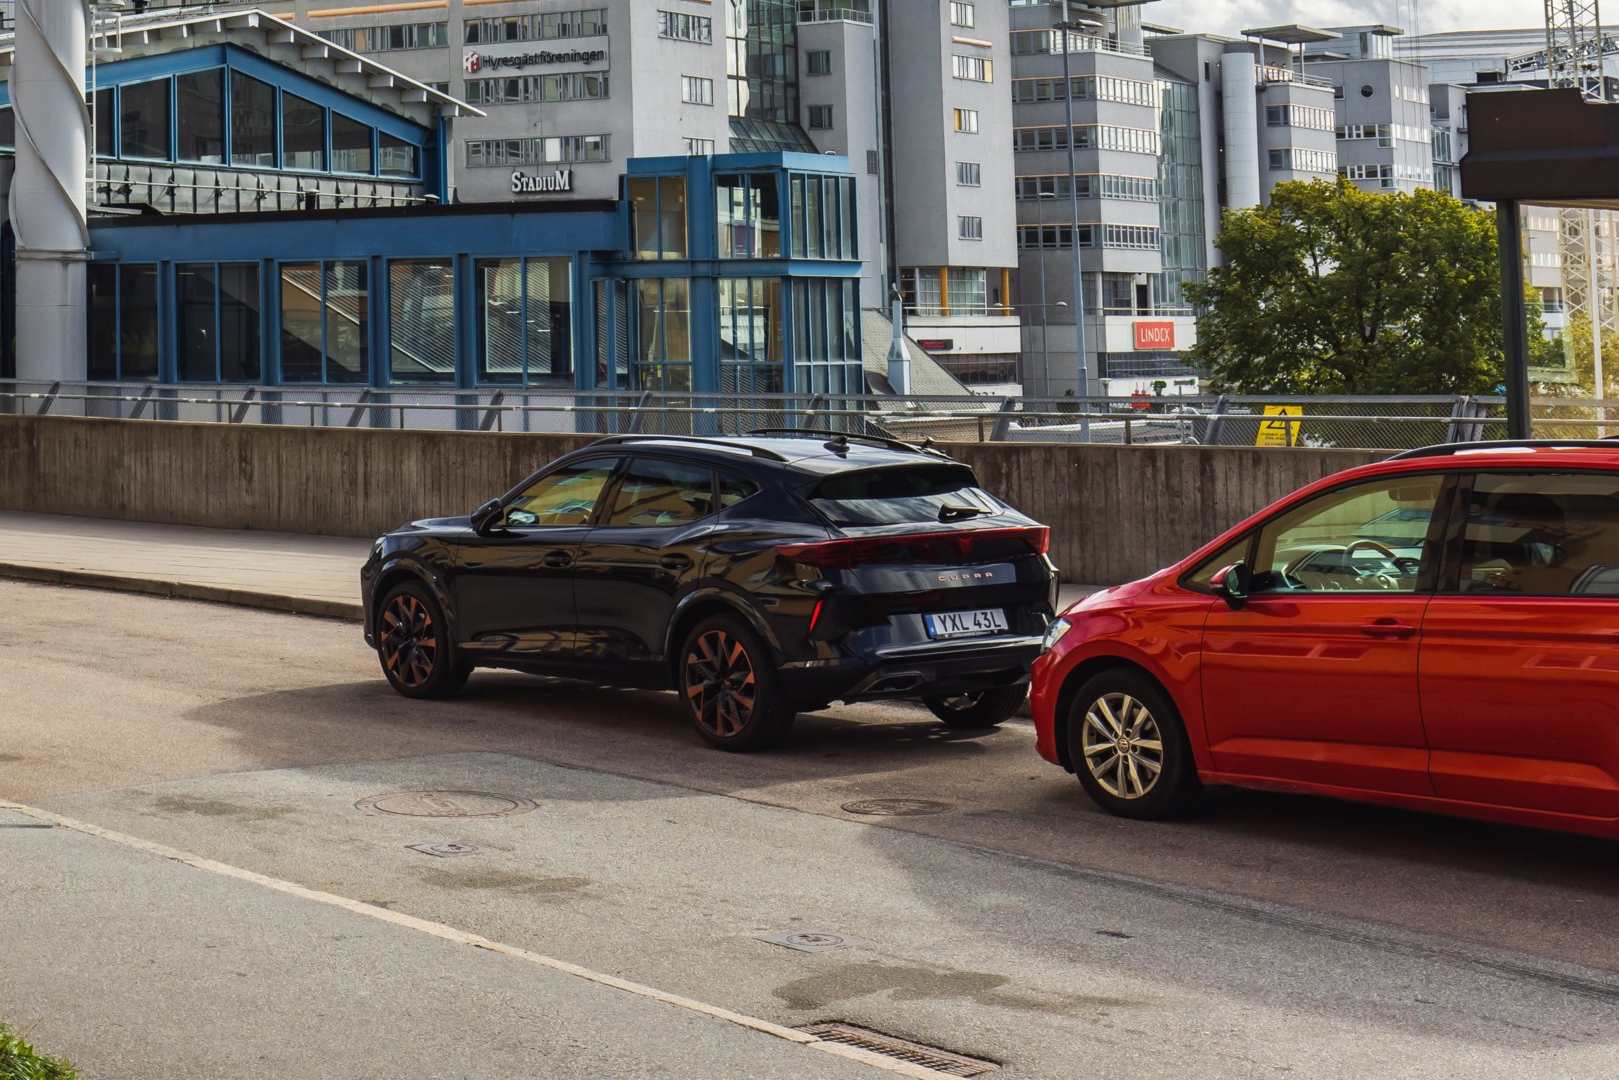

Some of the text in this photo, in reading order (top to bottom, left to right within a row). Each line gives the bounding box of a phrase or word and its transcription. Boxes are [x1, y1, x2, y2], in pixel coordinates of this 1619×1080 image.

[482, 48, 605, 70] Hyresgästföreningen
[1141, 328, 1170, 342] LINDEX
[938, 572, 992, 581] CUPRA
[938, 612, 1001, 632] YXL 43L
